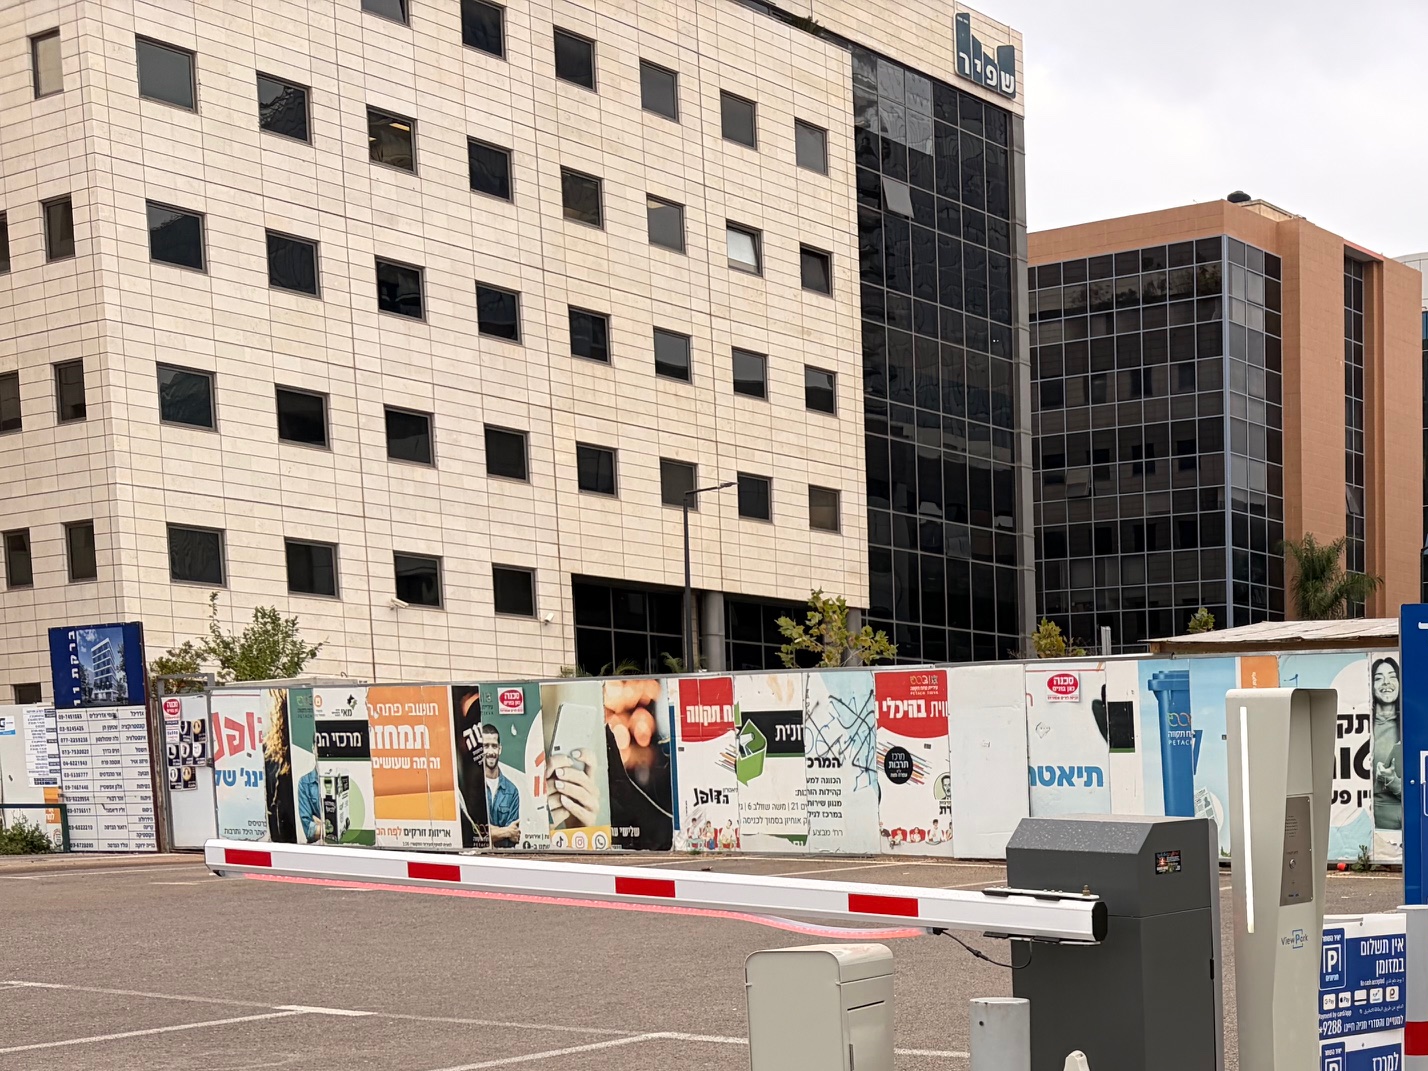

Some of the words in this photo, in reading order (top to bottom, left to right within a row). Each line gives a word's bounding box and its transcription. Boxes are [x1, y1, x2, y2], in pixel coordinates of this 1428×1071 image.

[958, 51, 1015, 94] שפיר
[1054, 677, 1074, 686] סכנה
[406, 704, 438, 716] תושבי
[686, 704, 720, 726] תקווה
[882, 697, 926, 720] בהיכלי
[333, 731, 362, 748] מרכזי
[372, 757, 412, 770] שעושים
[413, 758, 428, 770] מה
[430, 758, 440, 769] זה
[888, 760, 908, 768] תרבות
[791, 802, 798, 810] 21
[742, 816, 764, 824] לכניסה
[1360, 938, 1389, 956] תשלום
[1391, 938, 1404, 956] אין
[1376, 958, 1404, 978] במזומן
